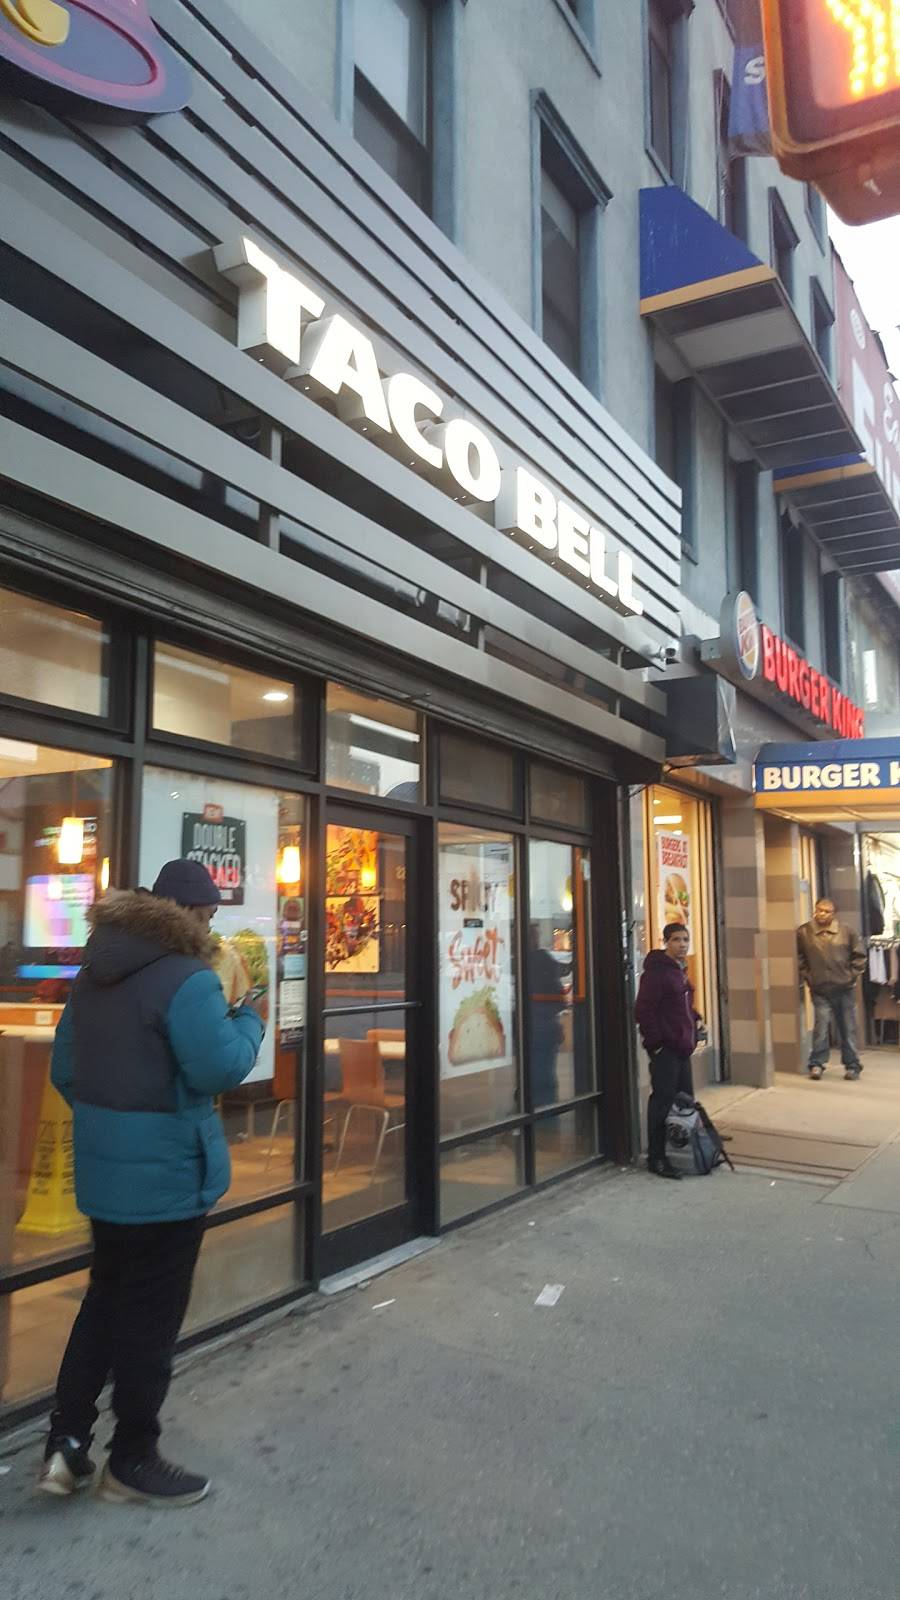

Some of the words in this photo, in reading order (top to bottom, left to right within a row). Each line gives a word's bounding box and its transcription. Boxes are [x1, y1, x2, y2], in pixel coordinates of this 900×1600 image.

[242, 237, 502, 502] TACO
[517, 466, 643, 615] BELL
[761, 624, 830, 725] BURGER
[763, 762, 881, 790] BURGER
[193, 823, 237, 853] DOUBLE
[186, 851, 241, 889] ACKED
